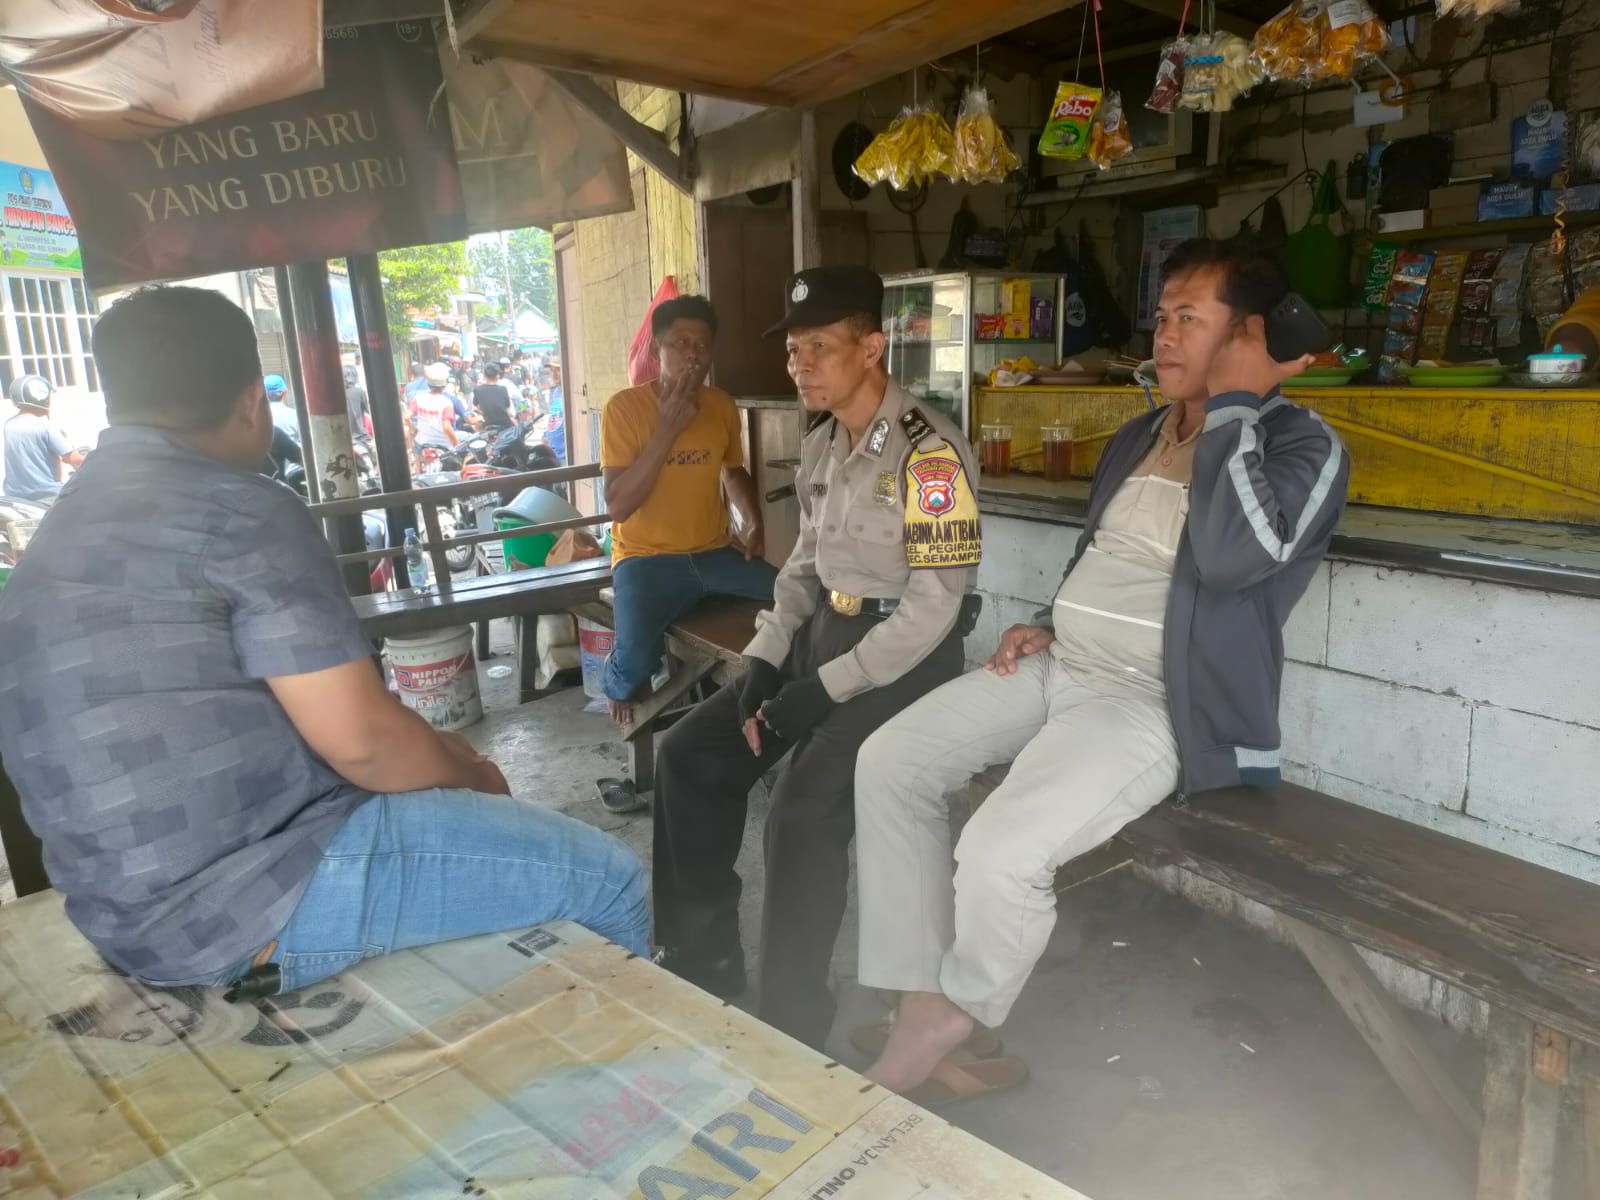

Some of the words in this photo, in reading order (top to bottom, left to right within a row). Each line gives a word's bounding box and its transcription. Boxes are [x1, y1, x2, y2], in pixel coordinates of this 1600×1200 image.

[1055, 100, 1092, 118] Rebo
[143, 124, 259, 169] YANG
[271, 110, 378, 154] BARU
[128, 176, 250, 223] YANG
[259, 156, 407, 205] DIBURU
[903, 519, 982, 545] ABINKAMTIBMA
[929, 542, 982, 555] PEGIRIAN
[411, 664, 457, 679] NIPPON
[851, 1112, 925, 1167] BELANJA
